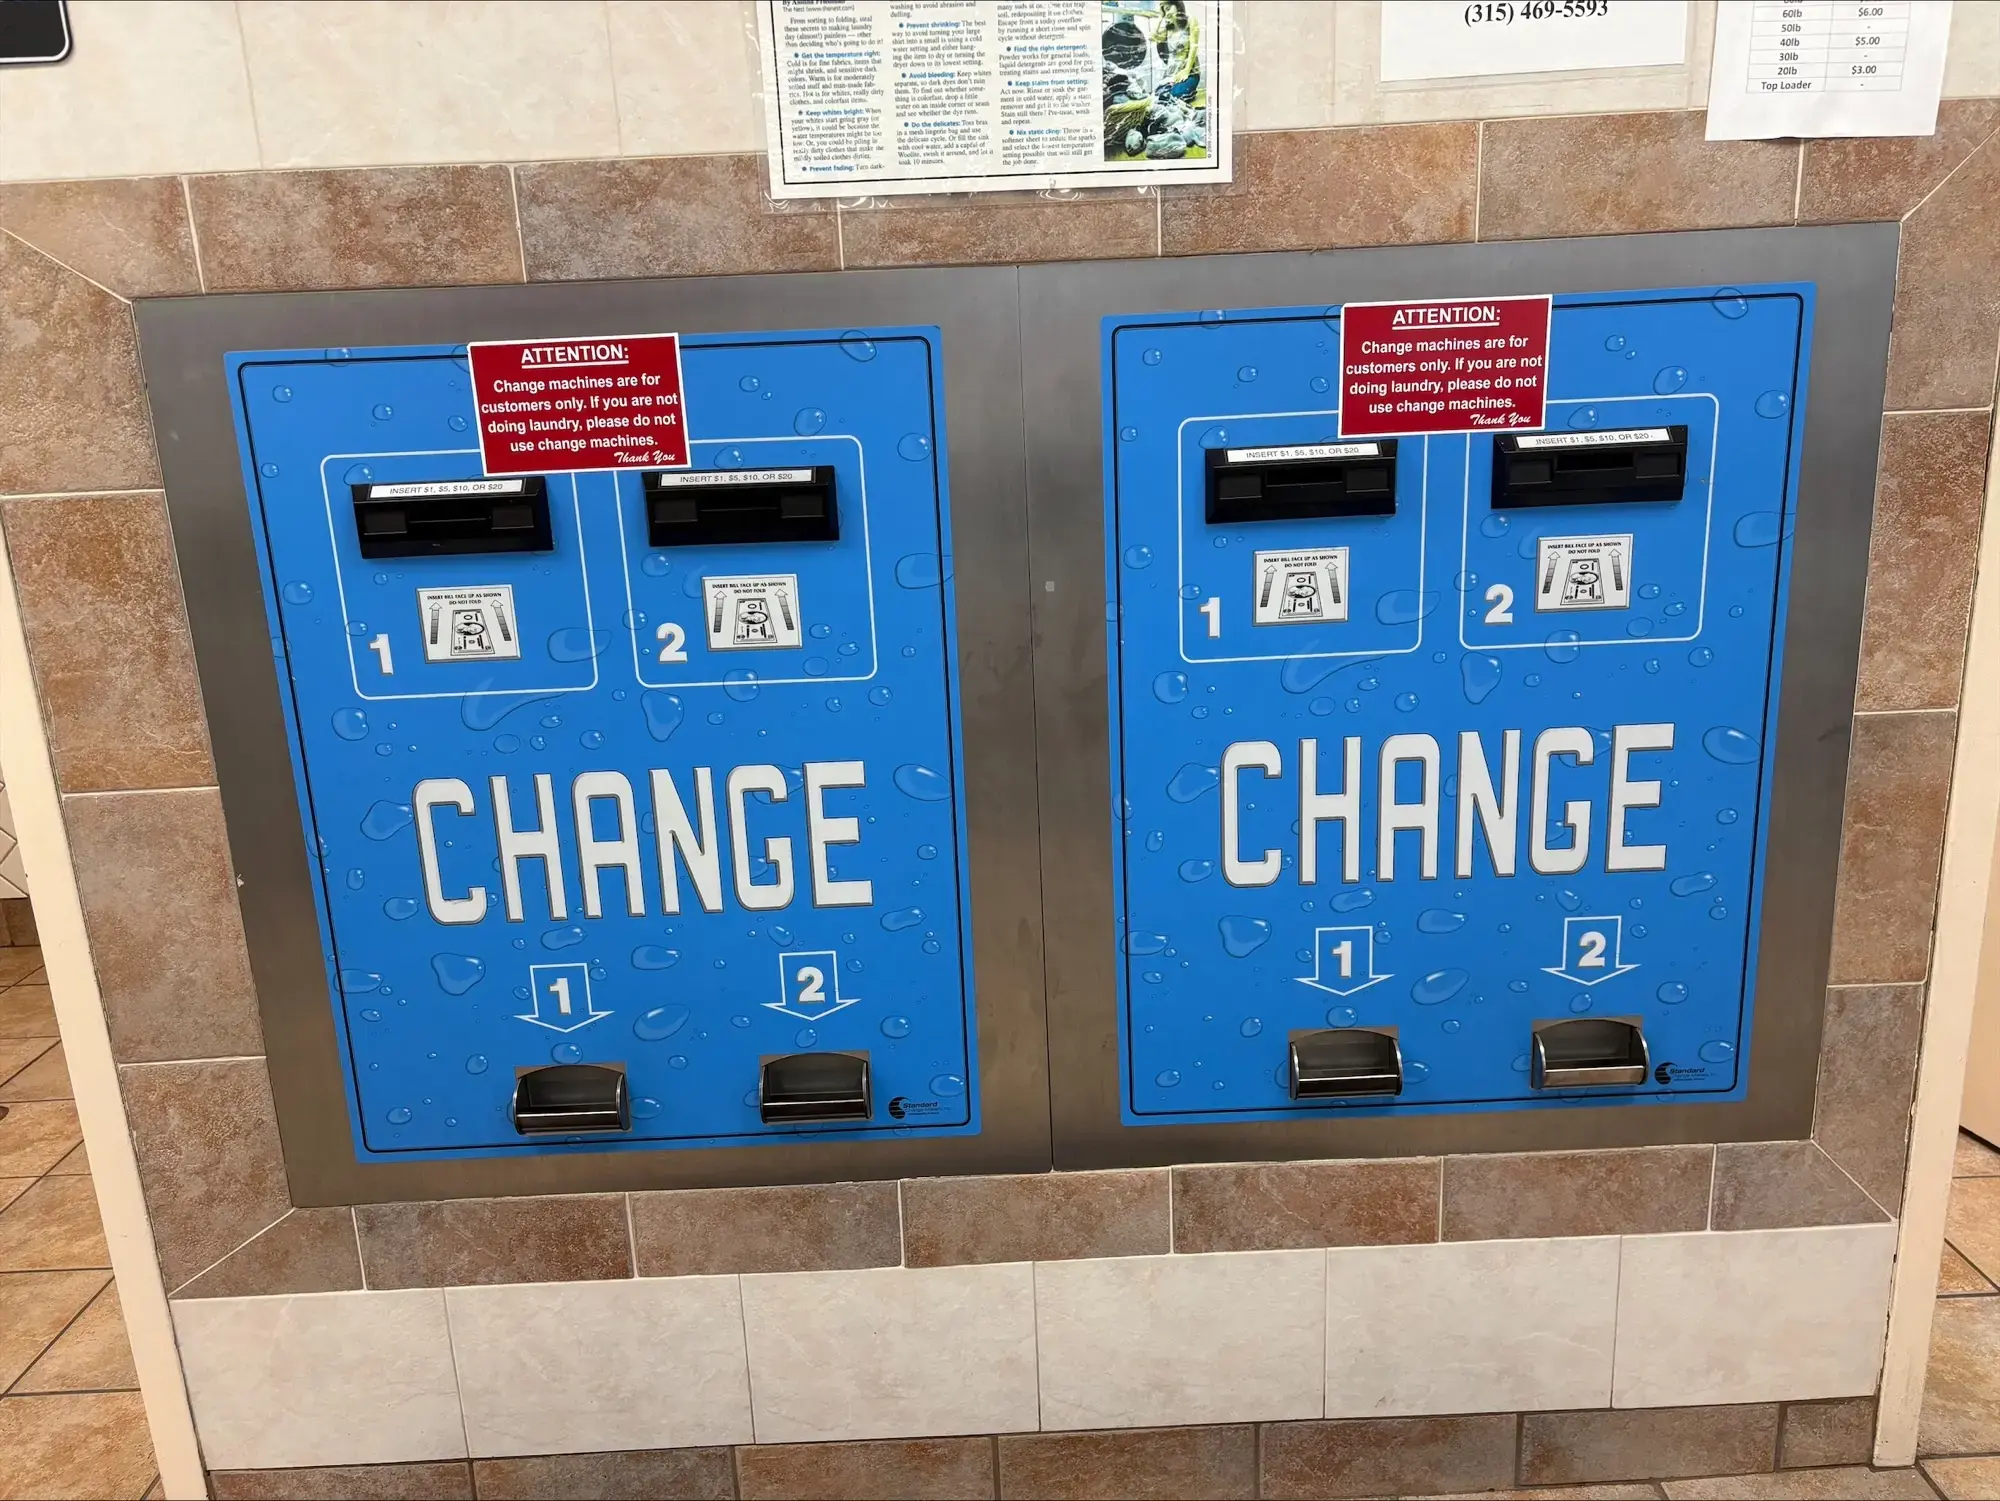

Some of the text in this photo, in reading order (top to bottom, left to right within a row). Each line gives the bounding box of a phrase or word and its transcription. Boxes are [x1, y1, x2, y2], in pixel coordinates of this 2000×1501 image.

[1464, 0, 1608, 27] (315) 469-5593
[1782, 8, 1883, 18] 60lb $6.00
[1782, 24, 1801, 32] 50lb
[1780, 37, 1880, 47] 40lb $5.00
[1779, 53, 1798, 61] 30lb
[1778, 66, 1876, 75] 20lb $3.00
[1762, 81, 1812, 91] Top Loader
[1392, 306, 1500, 325] ATTENTION:
[522, 344, 628, 364] ATTENTION:
[1362, 335, 1528, 355] Change machines are for
[1346, 354, 1542, 375] customers only. If you are not
[494, 373, 660, 395] Change machines are for
[1350, 375, 1537, 396] doing laundry, please do not
[481, 393, 678, 413] customers only. If you are not
[1369, 396, 1516, 413] use change machines.
[488, 413, 676, 434] doing laundry, please do not
[1470, 412, 1531, 426] Thank You
[511, 434, 658, 452] use change machines.
[1536, 437, 1567, 445] INSERT
[613, 450, 675, 464] Thank You
[390, 486, 421, 494] INSERT
[1485, 584, 1514, 624] 2
[1200, 597, 1220, 638] 1
[656, 623, 688, 663] 2
[369, 634, 394, 674] 1
[1220, 722, 1675, 888] CHANGE
[412, 760, 874, 926] CHANGE
[1331, 940, 1352, 978] 1
[1578, 931, 1606, 968] 2
[796, 966, 825, 1003] 2
[549, 977, 572, 1015] 1
